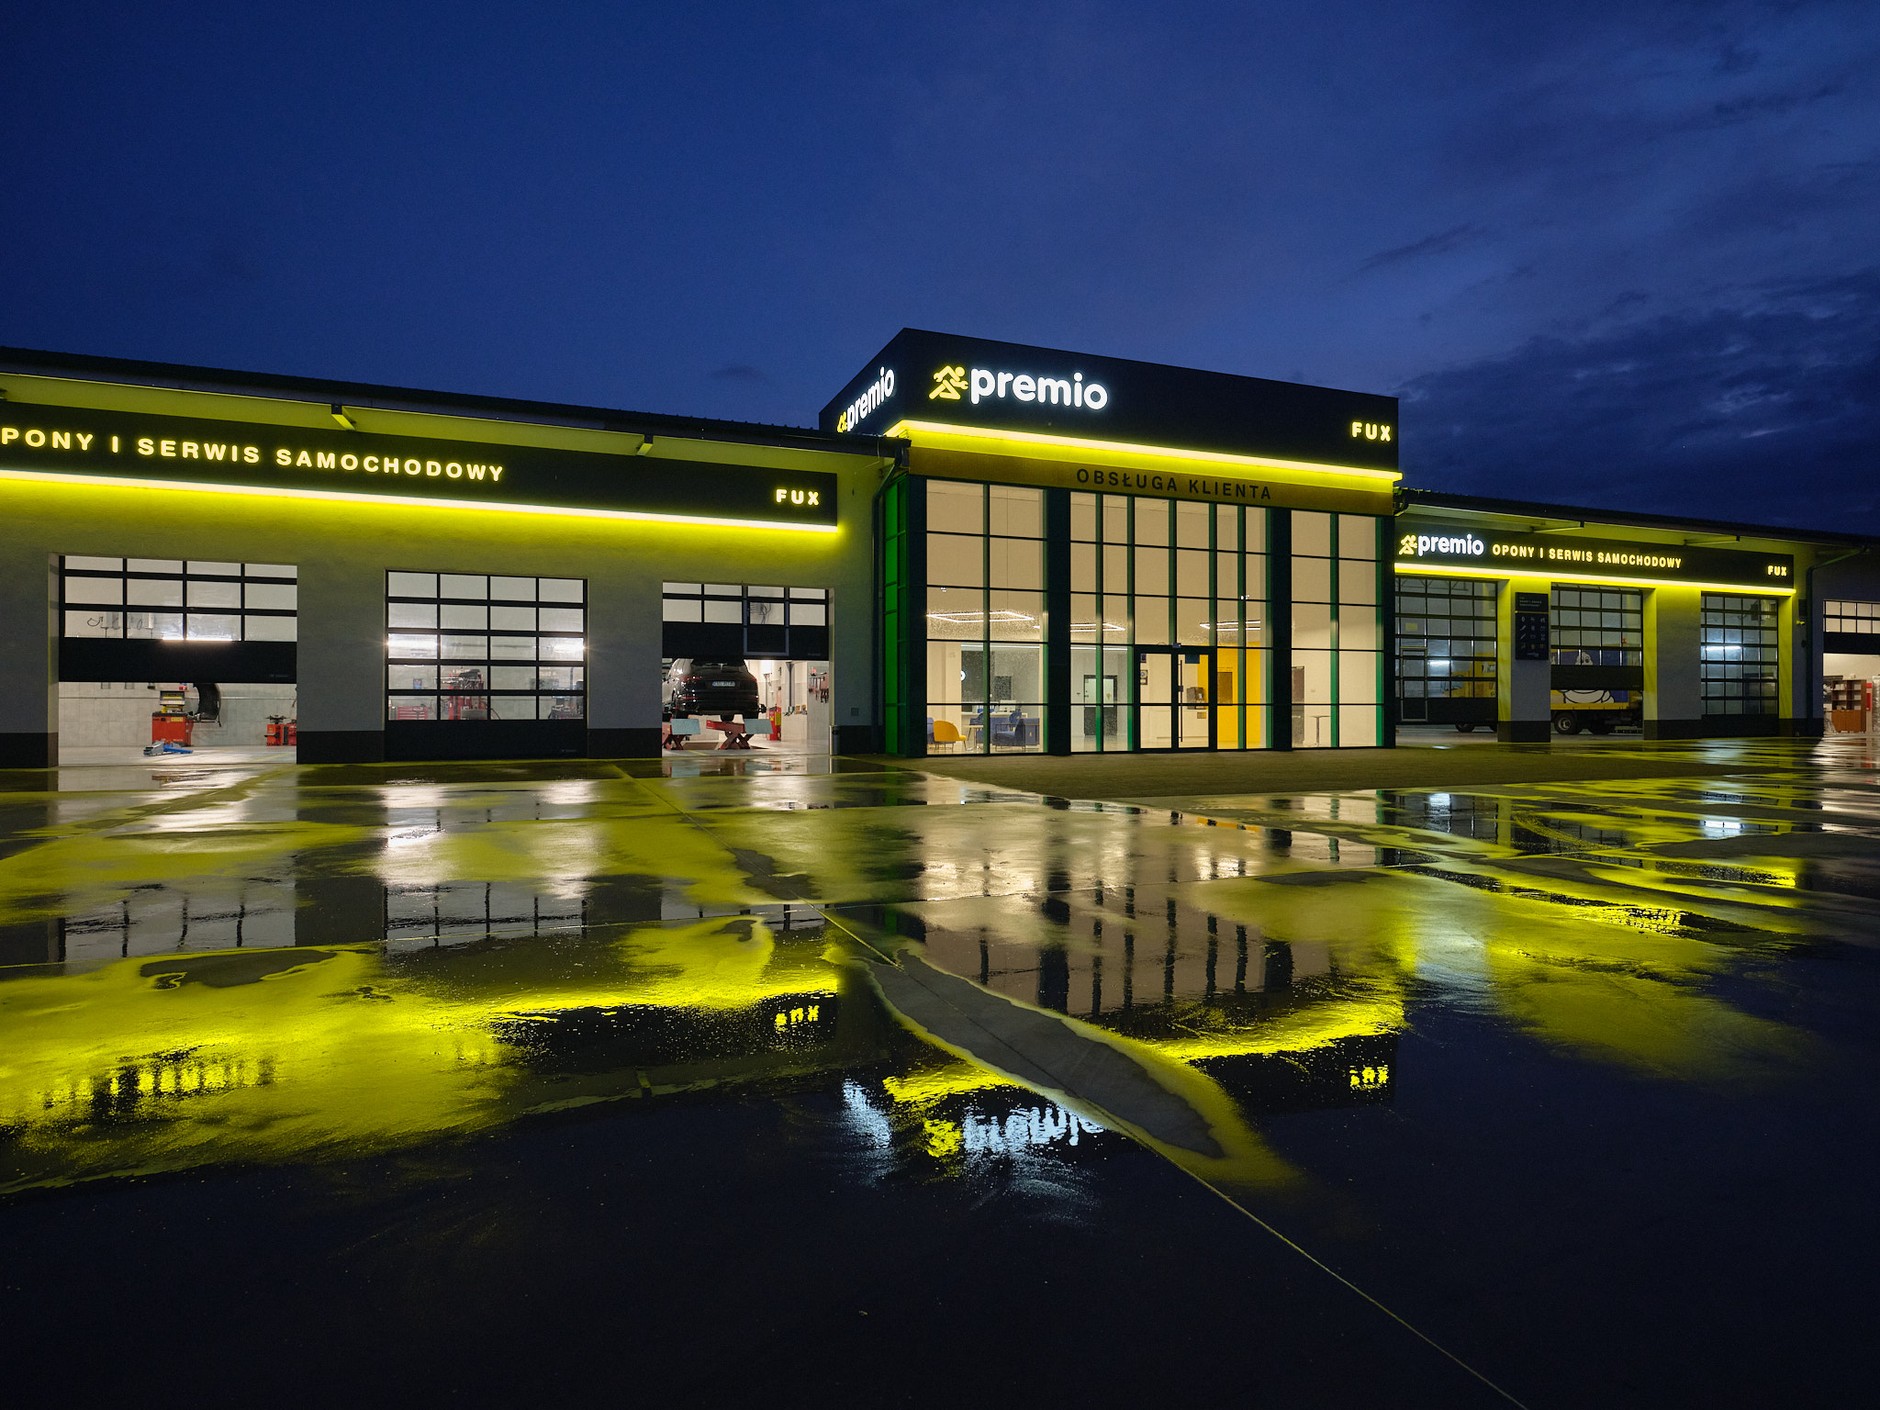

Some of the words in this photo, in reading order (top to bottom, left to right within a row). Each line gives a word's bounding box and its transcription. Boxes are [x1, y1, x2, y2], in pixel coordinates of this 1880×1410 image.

[847, 366, 895, 432] premio
[971, 368, 1108, 410] premio
[1351, 421, 1391, 441] FUX
[1, 427, 94, 451] PONY
[111, 435, 119, 454] I
[137, 438, 260, 464] SERWIS
[276, 449, 503, 481] SAMOCHODOWY
[776, 488, 819, 506] FUX
[1076, 468, 1177, 491] OBSŁUGA
[1189, 479, 1271, 500] KLIENTA
[1417, 533, 1484, 556] premio
[1492, 543, 1534, 558] OPONY
[1539, 547, 1544, 559] I
[1549, 548, 1593, 562] SERWIS
[1597, 553, 1682, 569] SAMOCHODOWY
[1767, 564, 1787, 577] FUX
